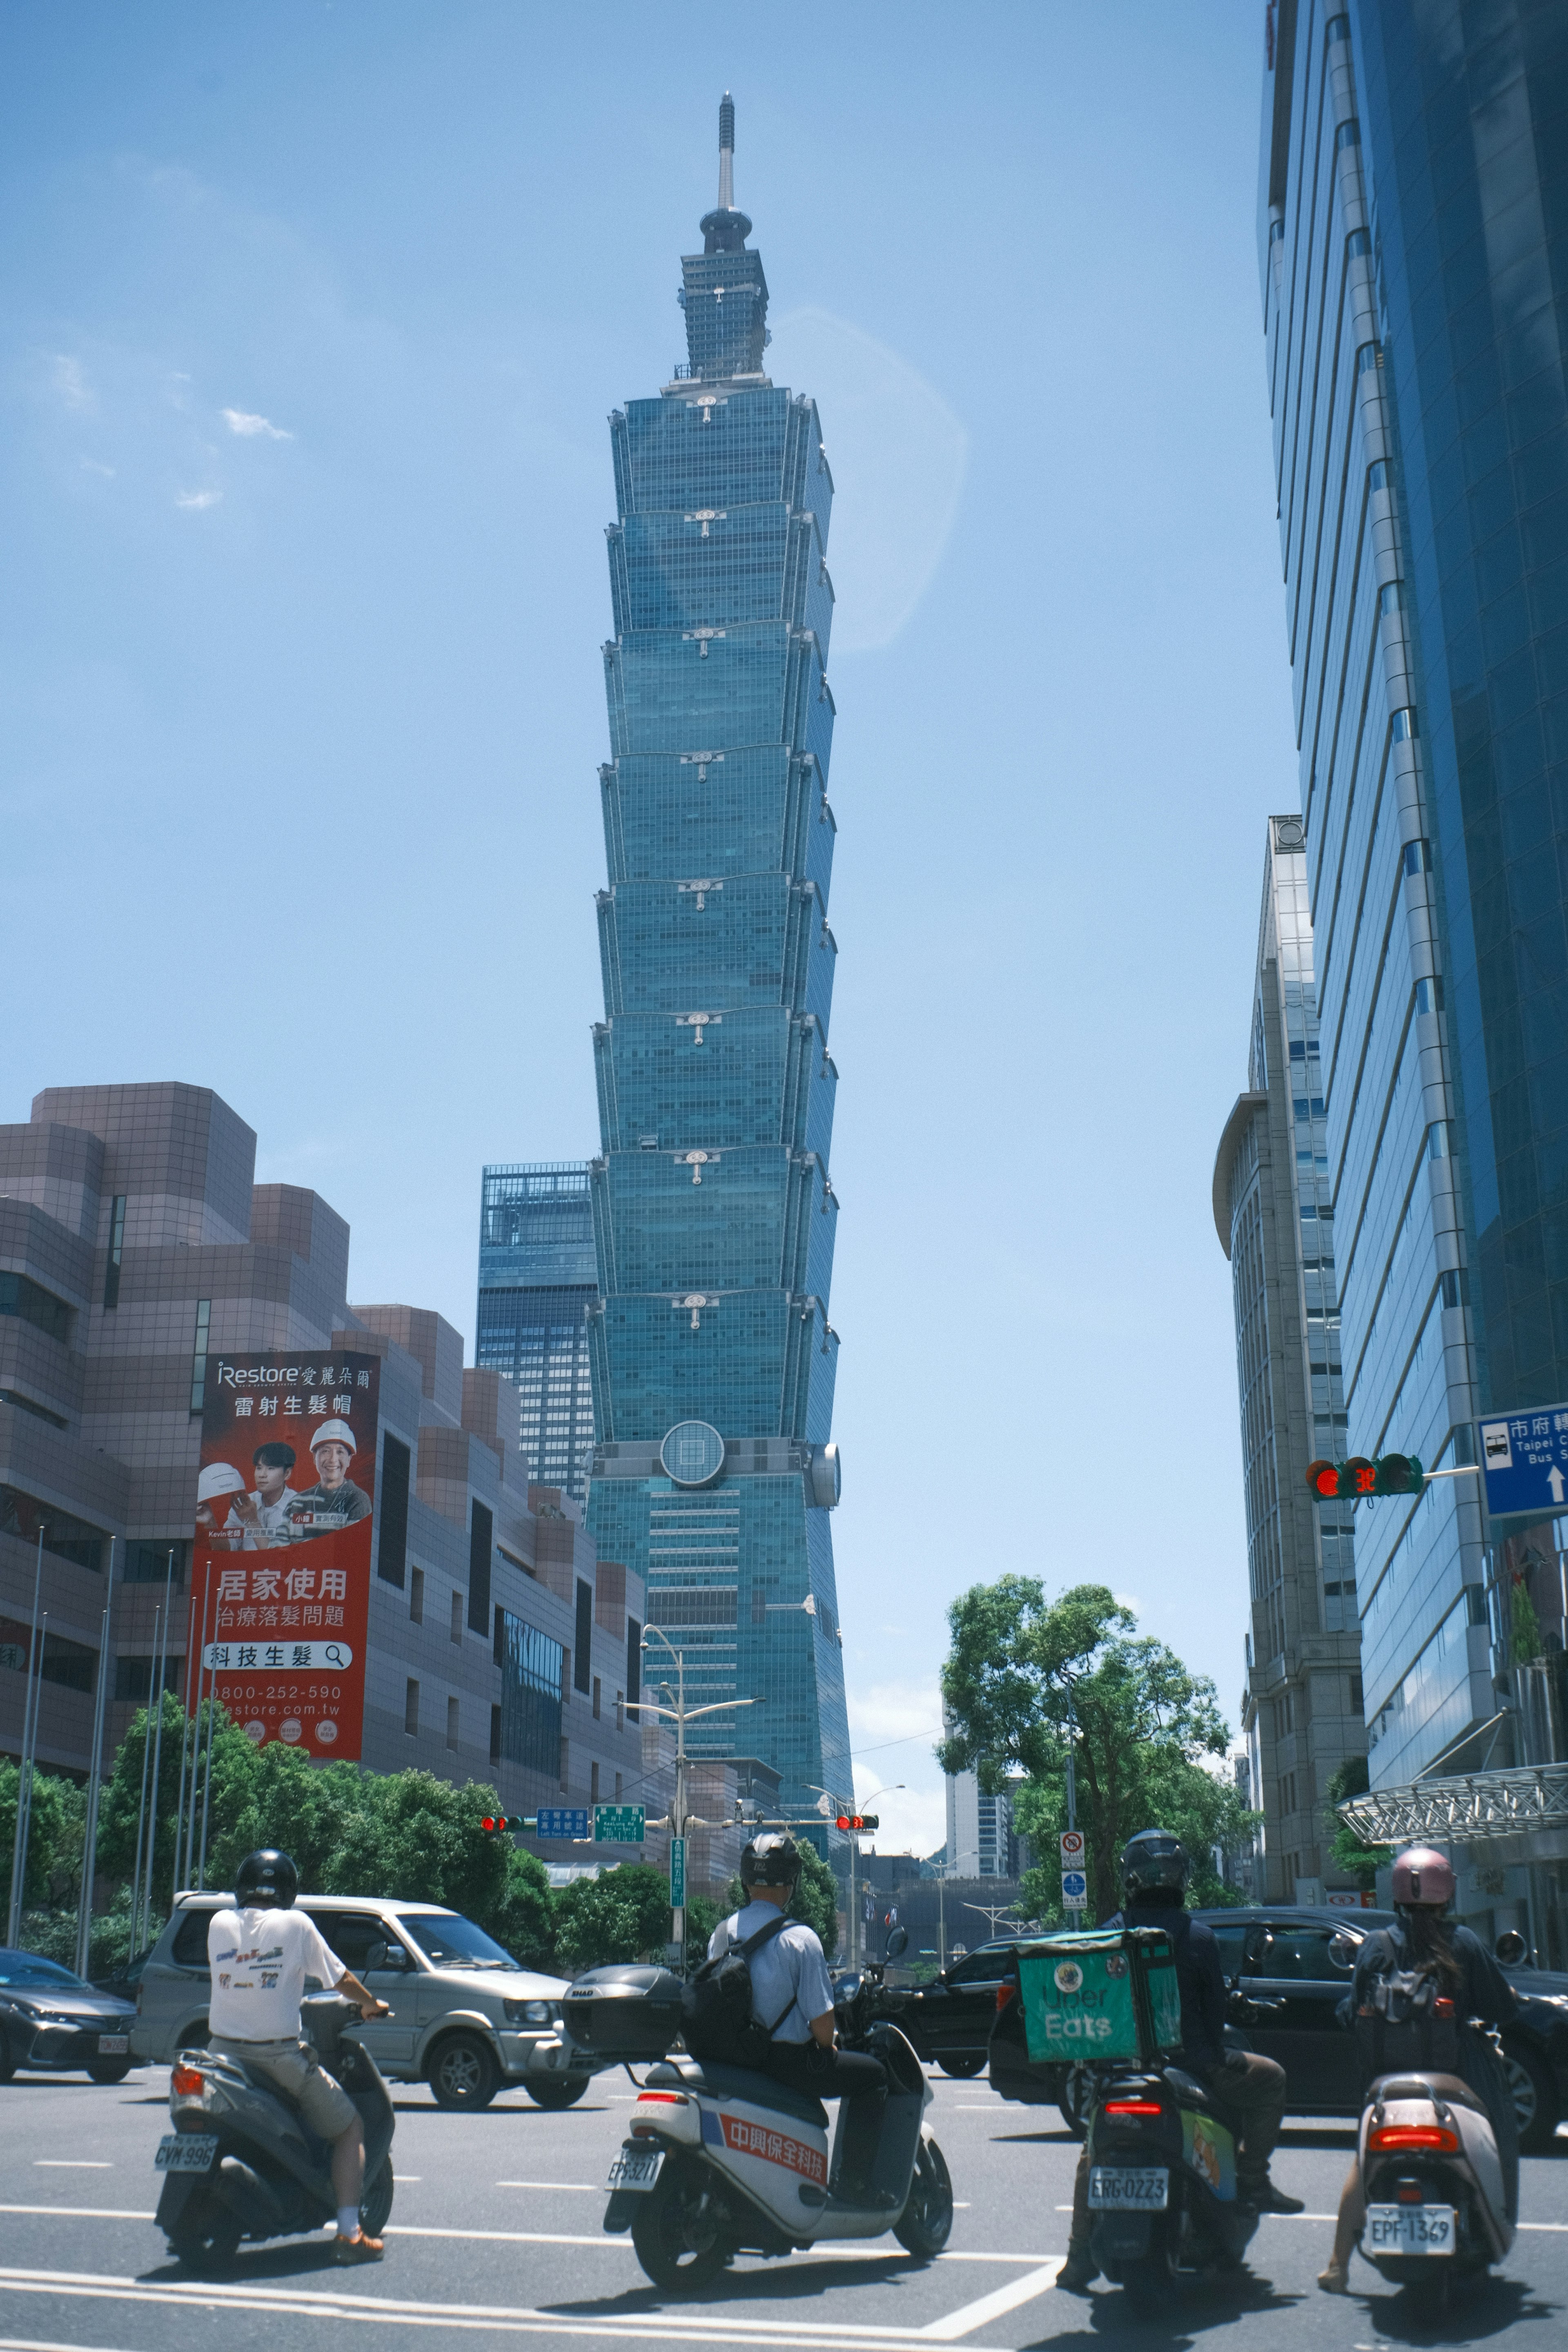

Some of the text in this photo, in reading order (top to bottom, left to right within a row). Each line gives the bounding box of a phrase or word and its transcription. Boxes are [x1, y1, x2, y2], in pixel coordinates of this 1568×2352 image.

[218, 1361, 298, 1388] iRestore
[301, 1366, 369, 1389] 愛麗朵爾
[235, 1394, 352, 1417] 雷射生髮帽
[1510, 1413, 1568, 1438] 市府轉
[1516, 1437, 1553, 1451] Taipei
[1529, 1454, 1552, 1464] Bus
[219, 1568, 347, 1601] 居家使用
[218, 1605, 344, 1627] 治療落髮問題
[210, 1645, 312, 1667] 科技生髮
[225, 1704, 339, 1715] estore.com.tw
[1045, 2013, 1113, 2039] Eats
[731, 2121, 822, 2180] 中興保全科技
